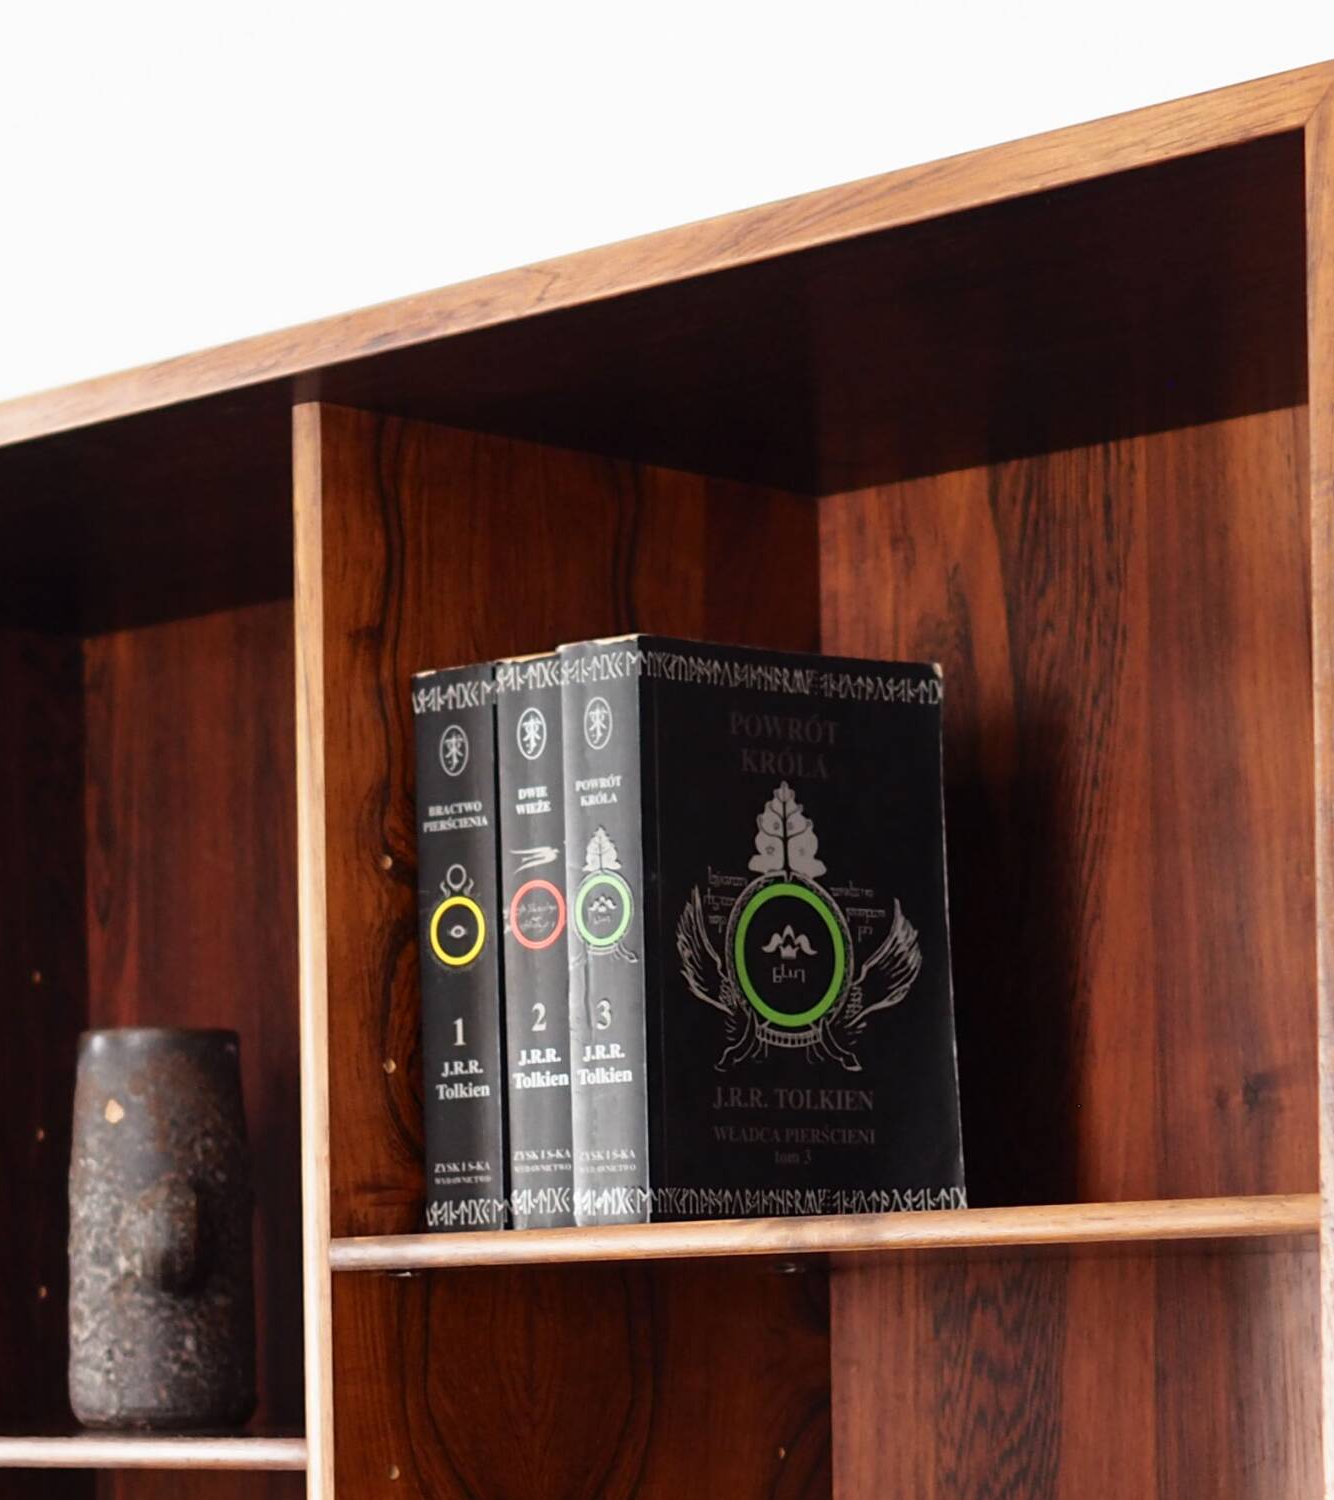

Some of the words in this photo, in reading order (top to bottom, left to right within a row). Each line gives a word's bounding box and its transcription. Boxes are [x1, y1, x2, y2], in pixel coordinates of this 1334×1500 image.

[730, 711, 839, 744] POWRÓT
[740, 746, 829, 779] KRÓLA
[575, 775, 622, 792] POWRÓT
[518, 786, 548, 800] DWIE
[580, 793, 618, 807] KRÓLA
[428, 801, 483, 817] BRACTWO
[516, 800, 551, 815] WIEŻE
[423, 816, 489, 833] PIERŚCIENIA
[531, 1002, 547, 1032] 2
[596, 1000, 612, 1030] 3
[453, 1017, 466, 1046] 1
[518, 1048, 562, 1066] J.R.R.
[582, 1043, 626, 1062] J.R.R.
[441, 1060, 484, 1077] J.R.R.
[577, 1067, 633, 1086] Tolkien
[513, 1071, 570, 1089] Tolkien
[435, 1083, 491, 1100] Tolkien
[712, 1086, 768, 1109] J.R.R.
[773, 1087, 875, 1112] TOLKIEN
[785, 1124, 876, 1145] PIERŚCIENI
[804, 1149, 812, 1165] 3
